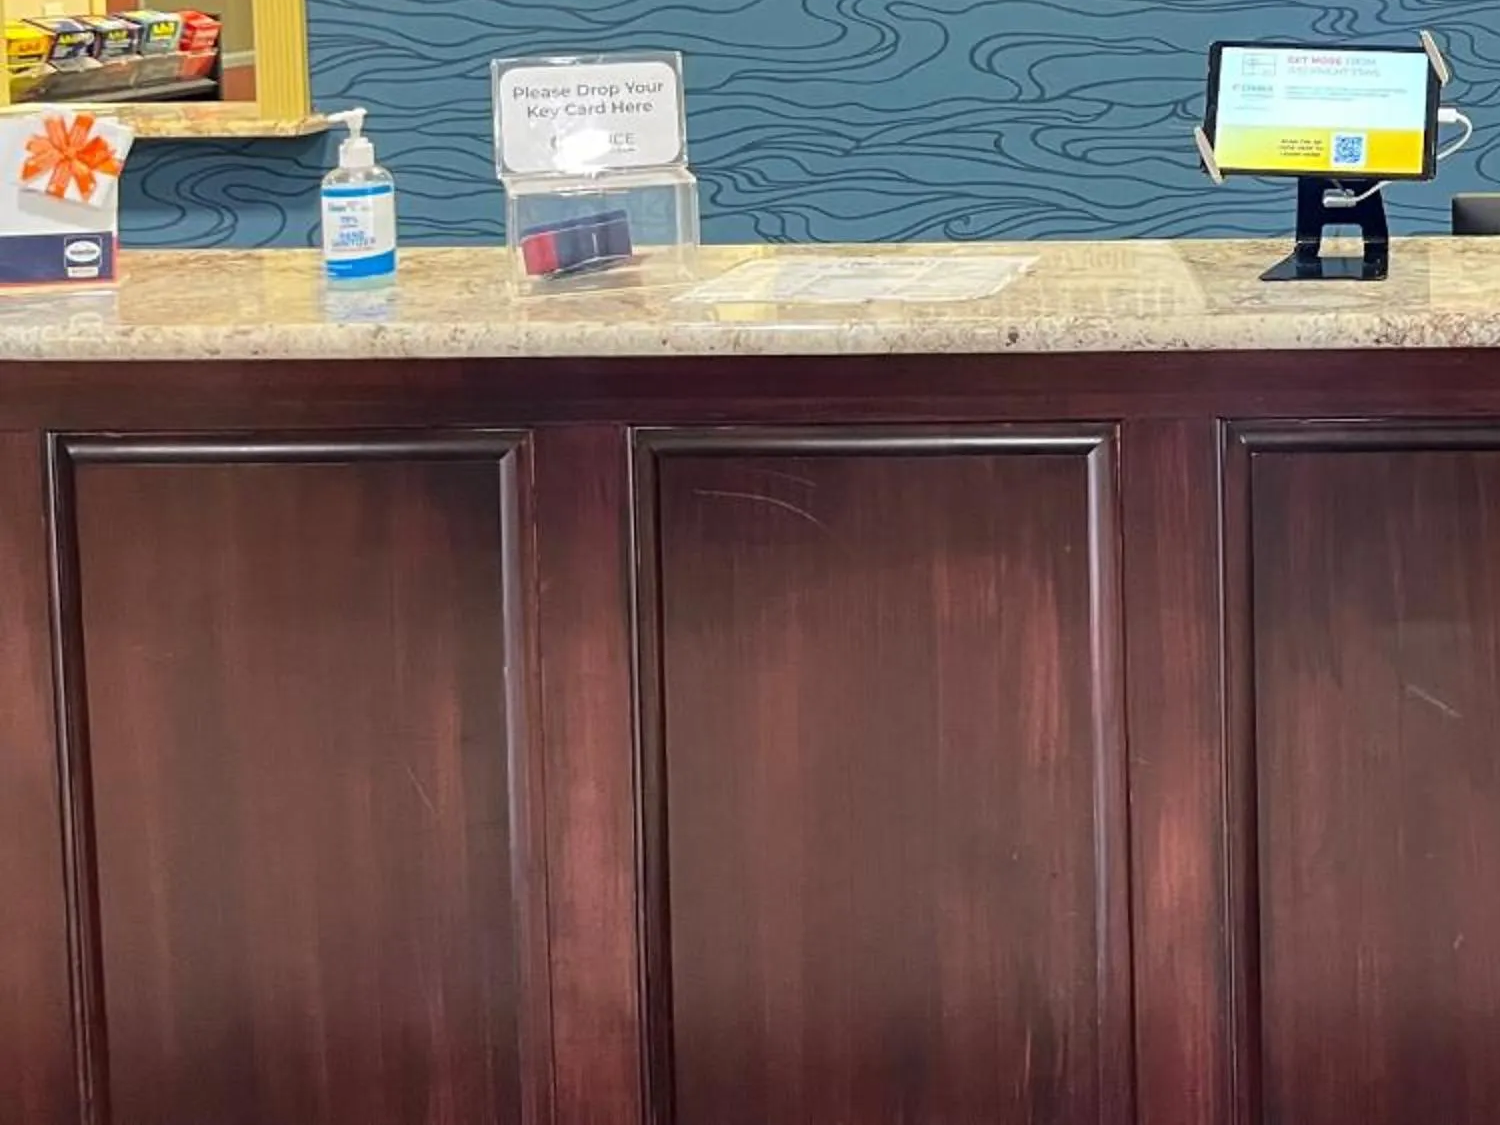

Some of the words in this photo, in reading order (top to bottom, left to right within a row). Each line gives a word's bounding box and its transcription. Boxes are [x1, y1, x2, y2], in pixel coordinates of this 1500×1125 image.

[512, 85, 571, 101] Please
[576, 83, 620, 98] Drop
[625, 81, 664, 95] Your
[526, 104, 560, 120] Key
[564, 101, 607, 117] Card
[611, 99, 654, 114] Here
